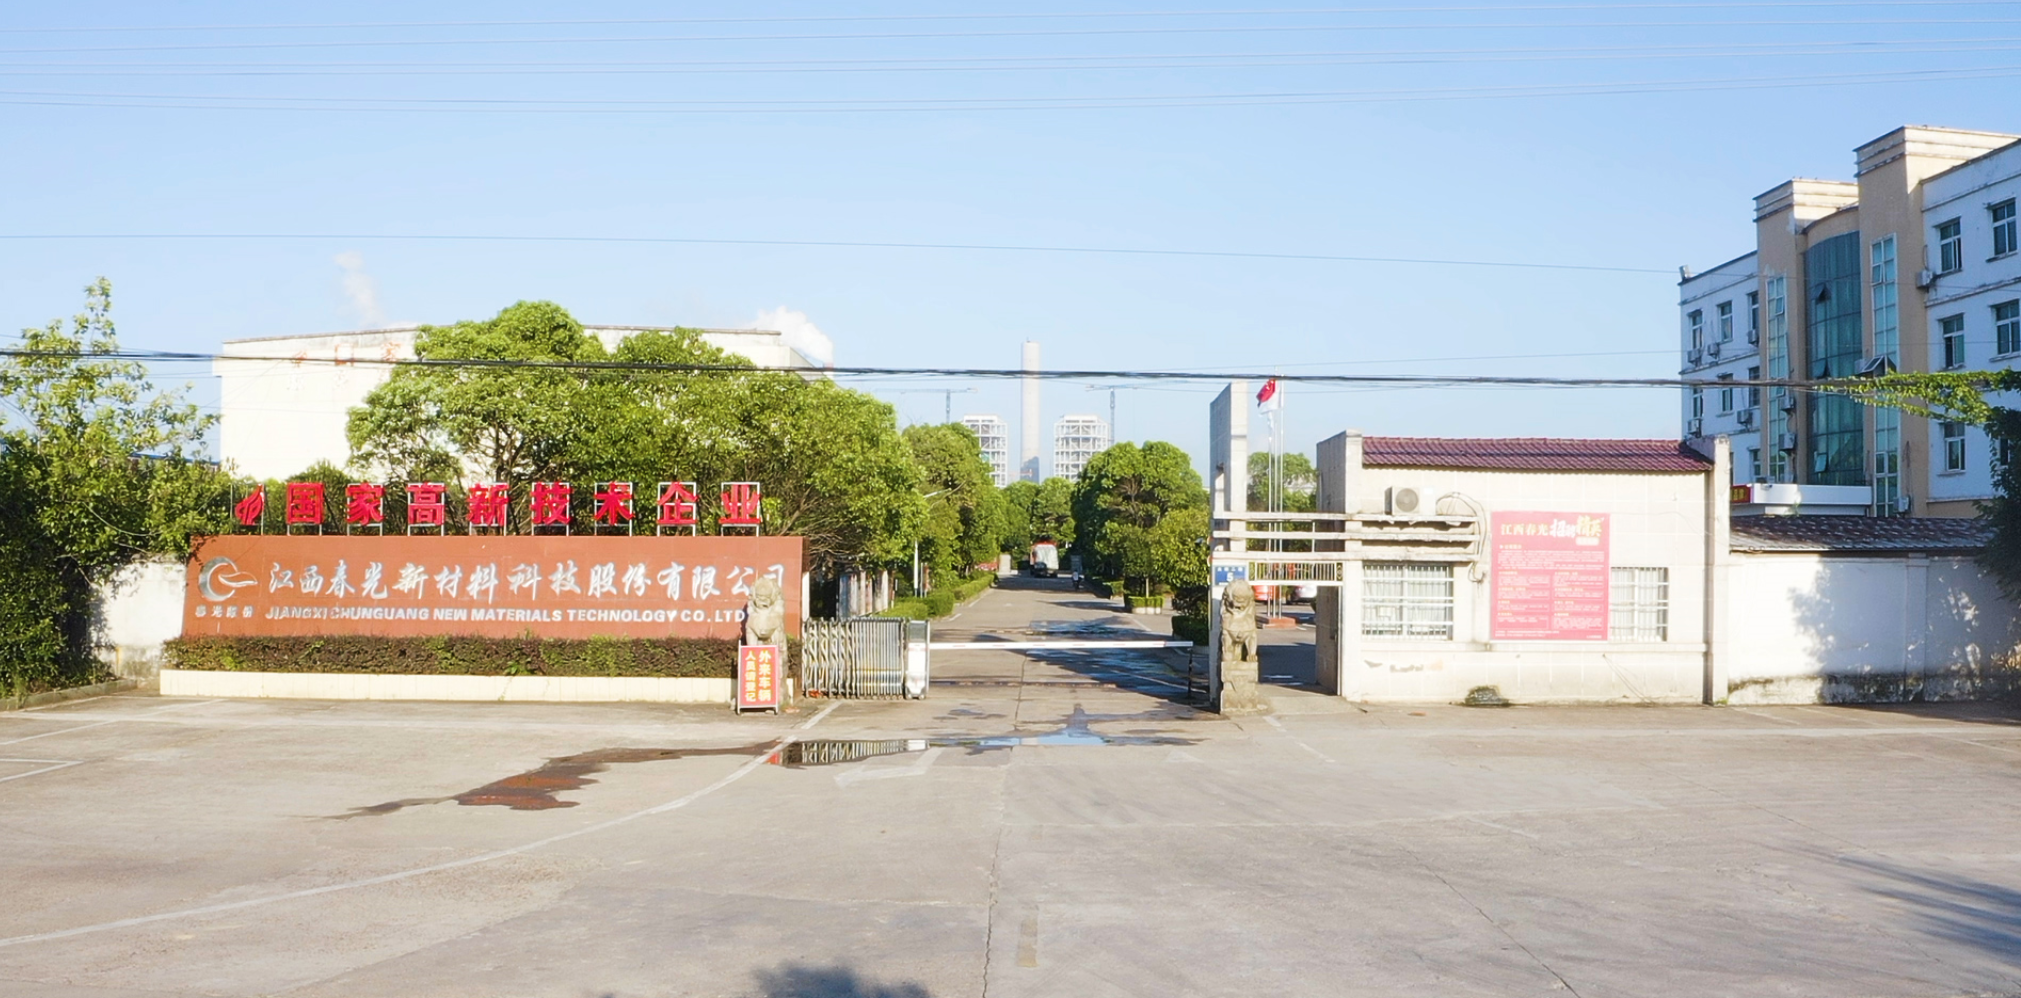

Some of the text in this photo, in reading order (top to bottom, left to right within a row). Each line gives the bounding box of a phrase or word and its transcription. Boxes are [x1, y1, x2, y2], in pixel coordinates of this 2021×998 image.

[286, 481, 761, 526] 国家高新技术企业
[265, 605, 327, 620] JIANGXI
[329, 606, 429, 621] CHUNGUANG
[433, 607, 468, 621] NEW
[470, 608, 562, 622] MATERIALS
[567, 609, 678, 623] TECHNOLOGY
[745, 651, 756, 702] 人员请登记
[759, 651, 771, 701] 外来车辆
